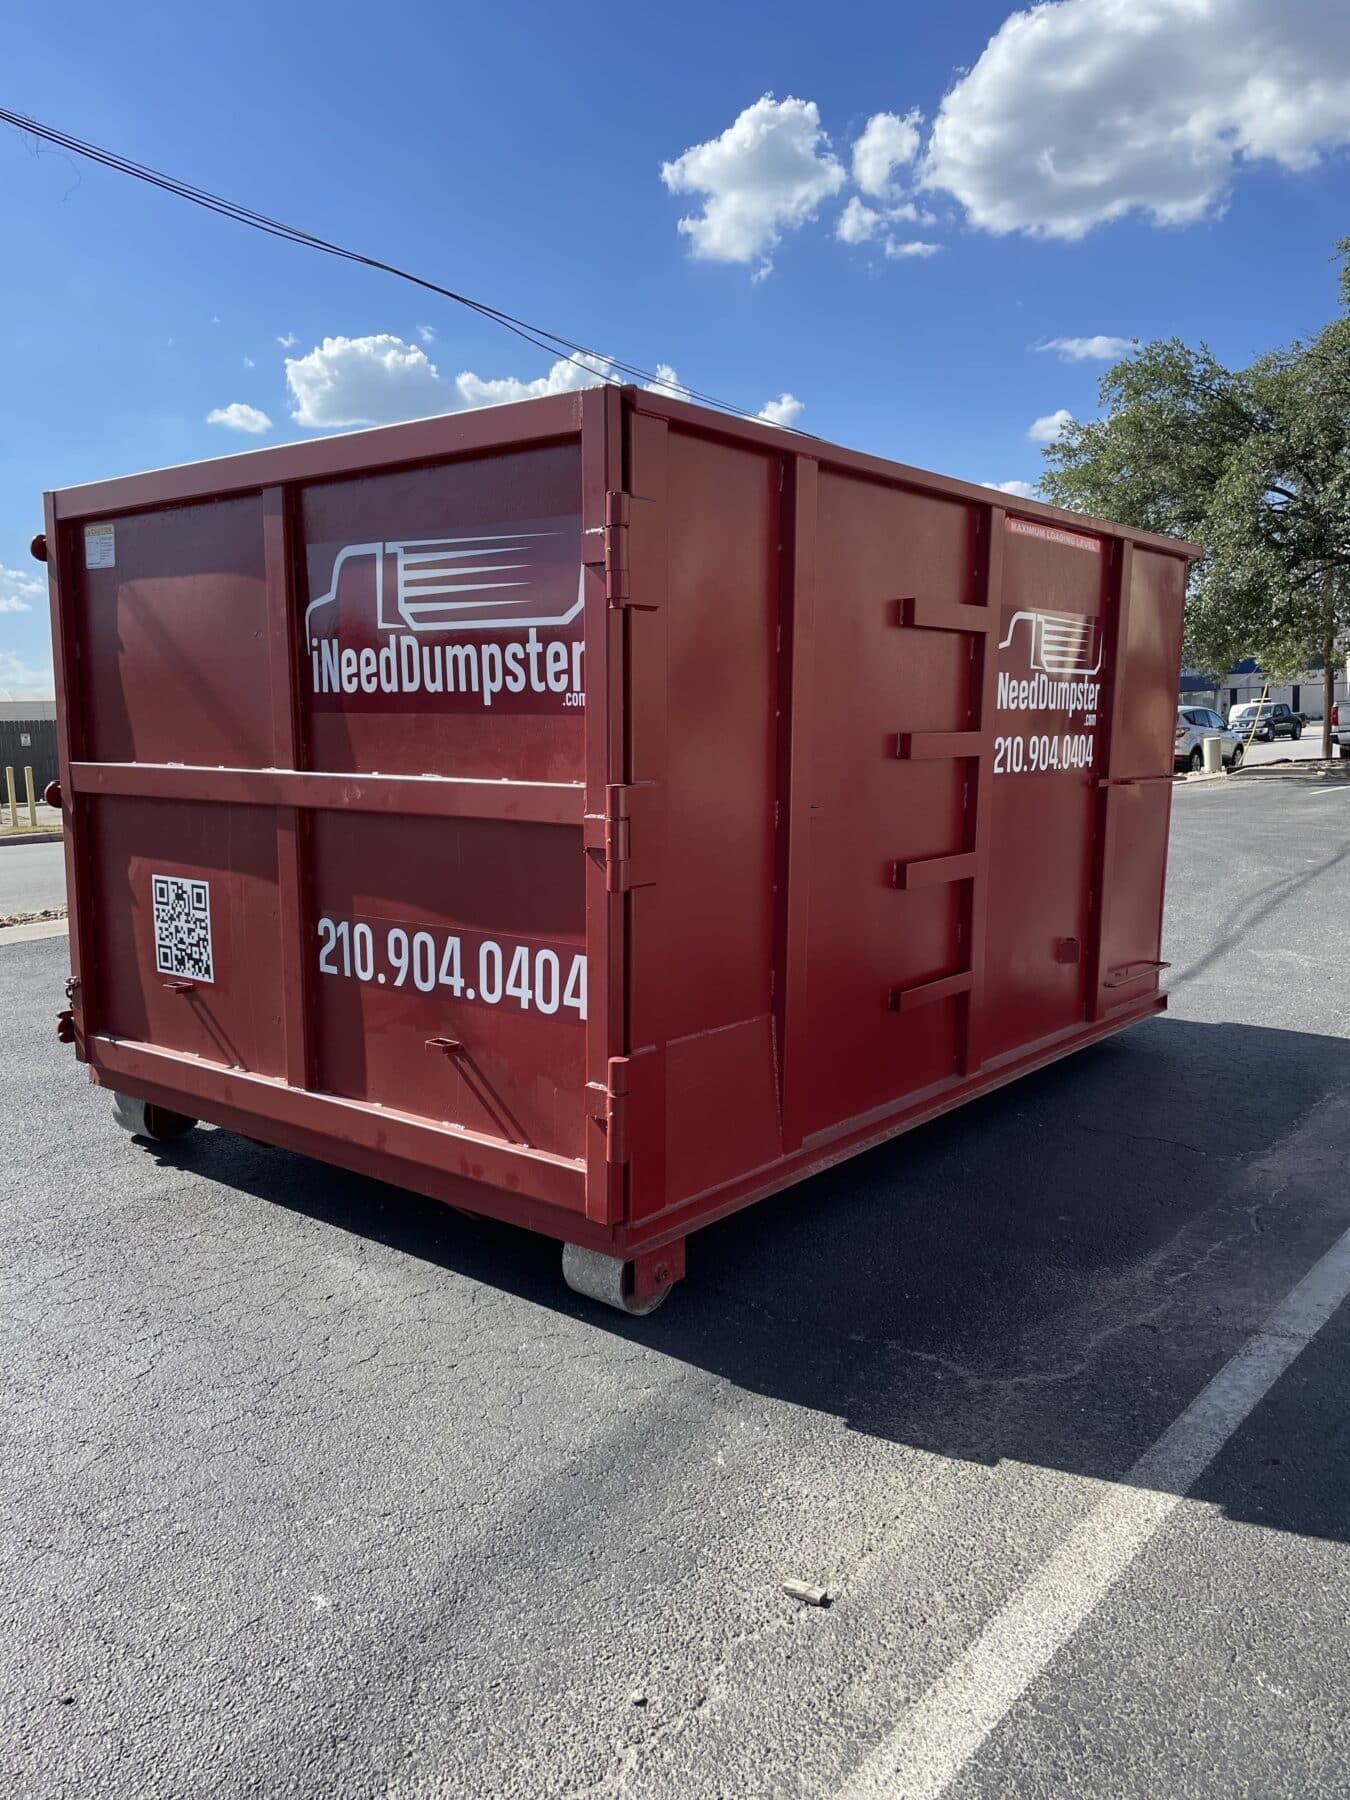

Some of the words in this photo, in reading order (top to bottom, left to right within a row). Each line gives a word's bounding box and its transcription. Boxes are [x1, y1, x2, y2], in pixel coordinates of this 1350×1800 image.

[1010, 521, 1045, 538] MAXIMUM
[1046, 530, 1076, 545] LOADING
[1076, 538, 1096, 551] LEVEL
[311, 627, 585, 705] iNeedDumpster
[997, 671, 1101, 718] NeedDumpster
[993, 735, 1094, 773] 210.904.0404
[317, 917, 588, 1020] 210.904.0404
